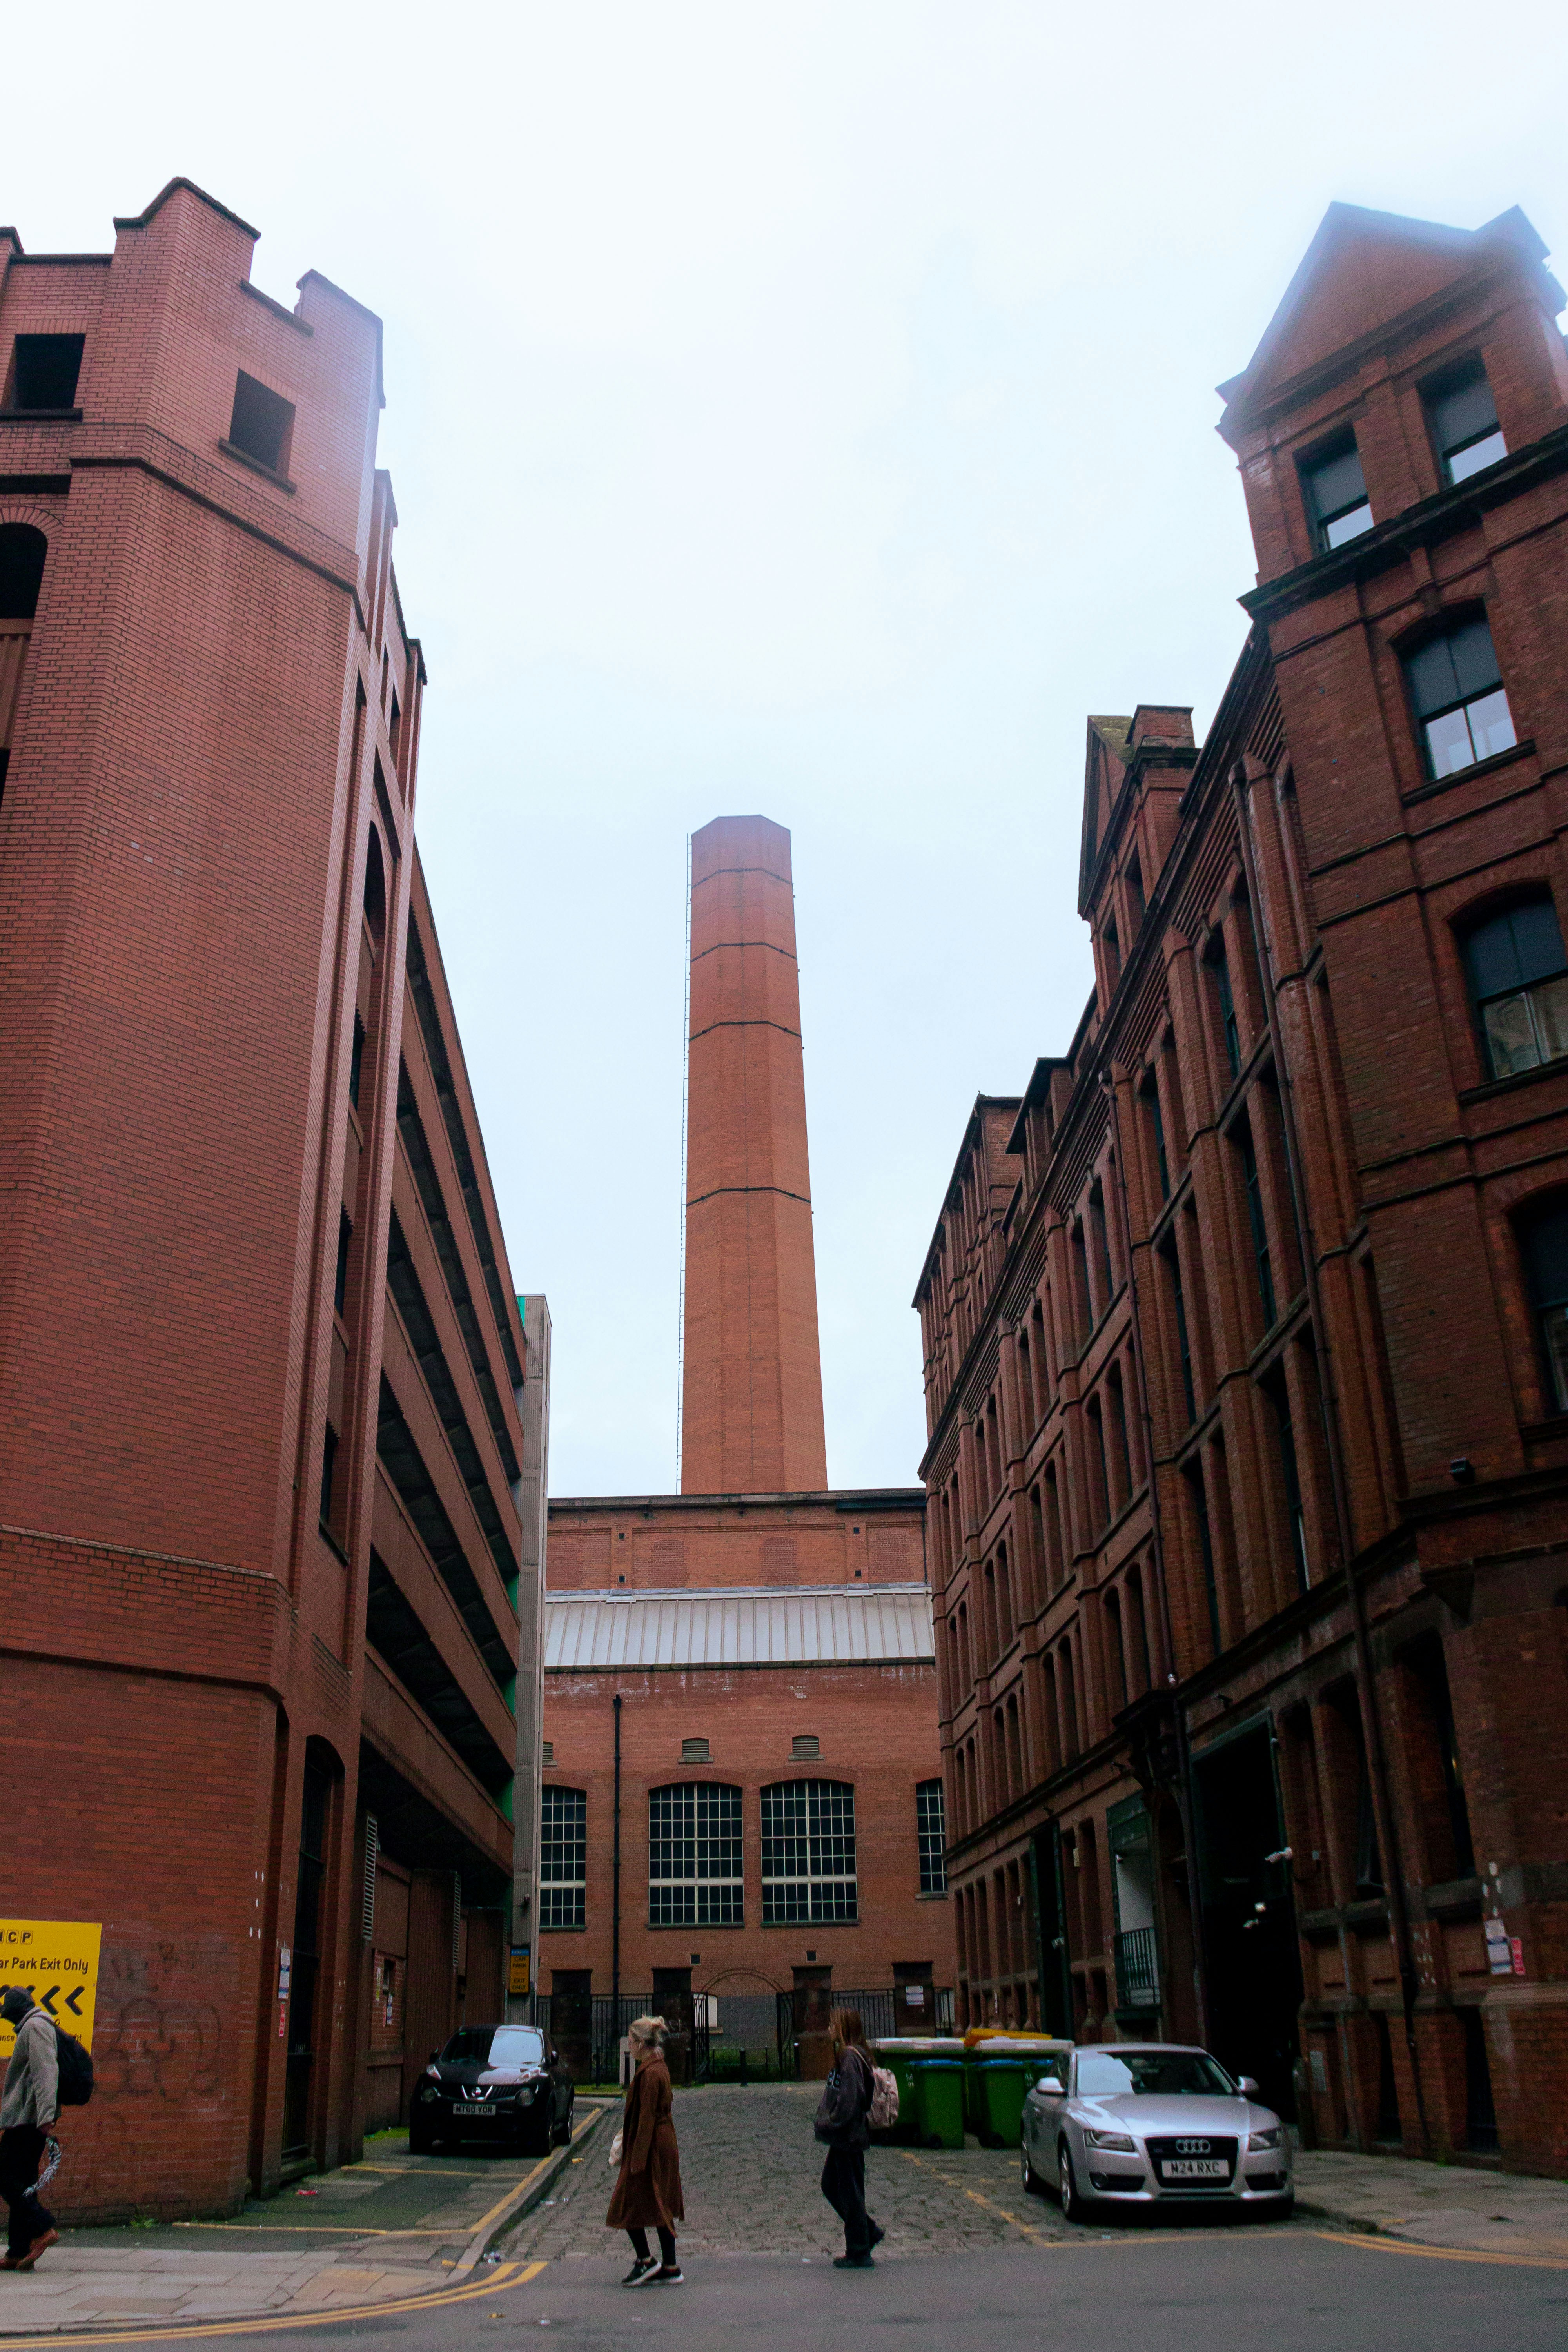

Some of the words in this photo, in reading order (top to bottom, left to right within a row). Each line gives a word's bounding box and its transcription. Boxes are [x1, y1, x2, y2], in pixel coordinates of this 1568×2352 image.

[11, 1957, 38, 1969] Park
[40, 1958, 61, 1970] Exit
[64, 1958, 89, 1975] Only
